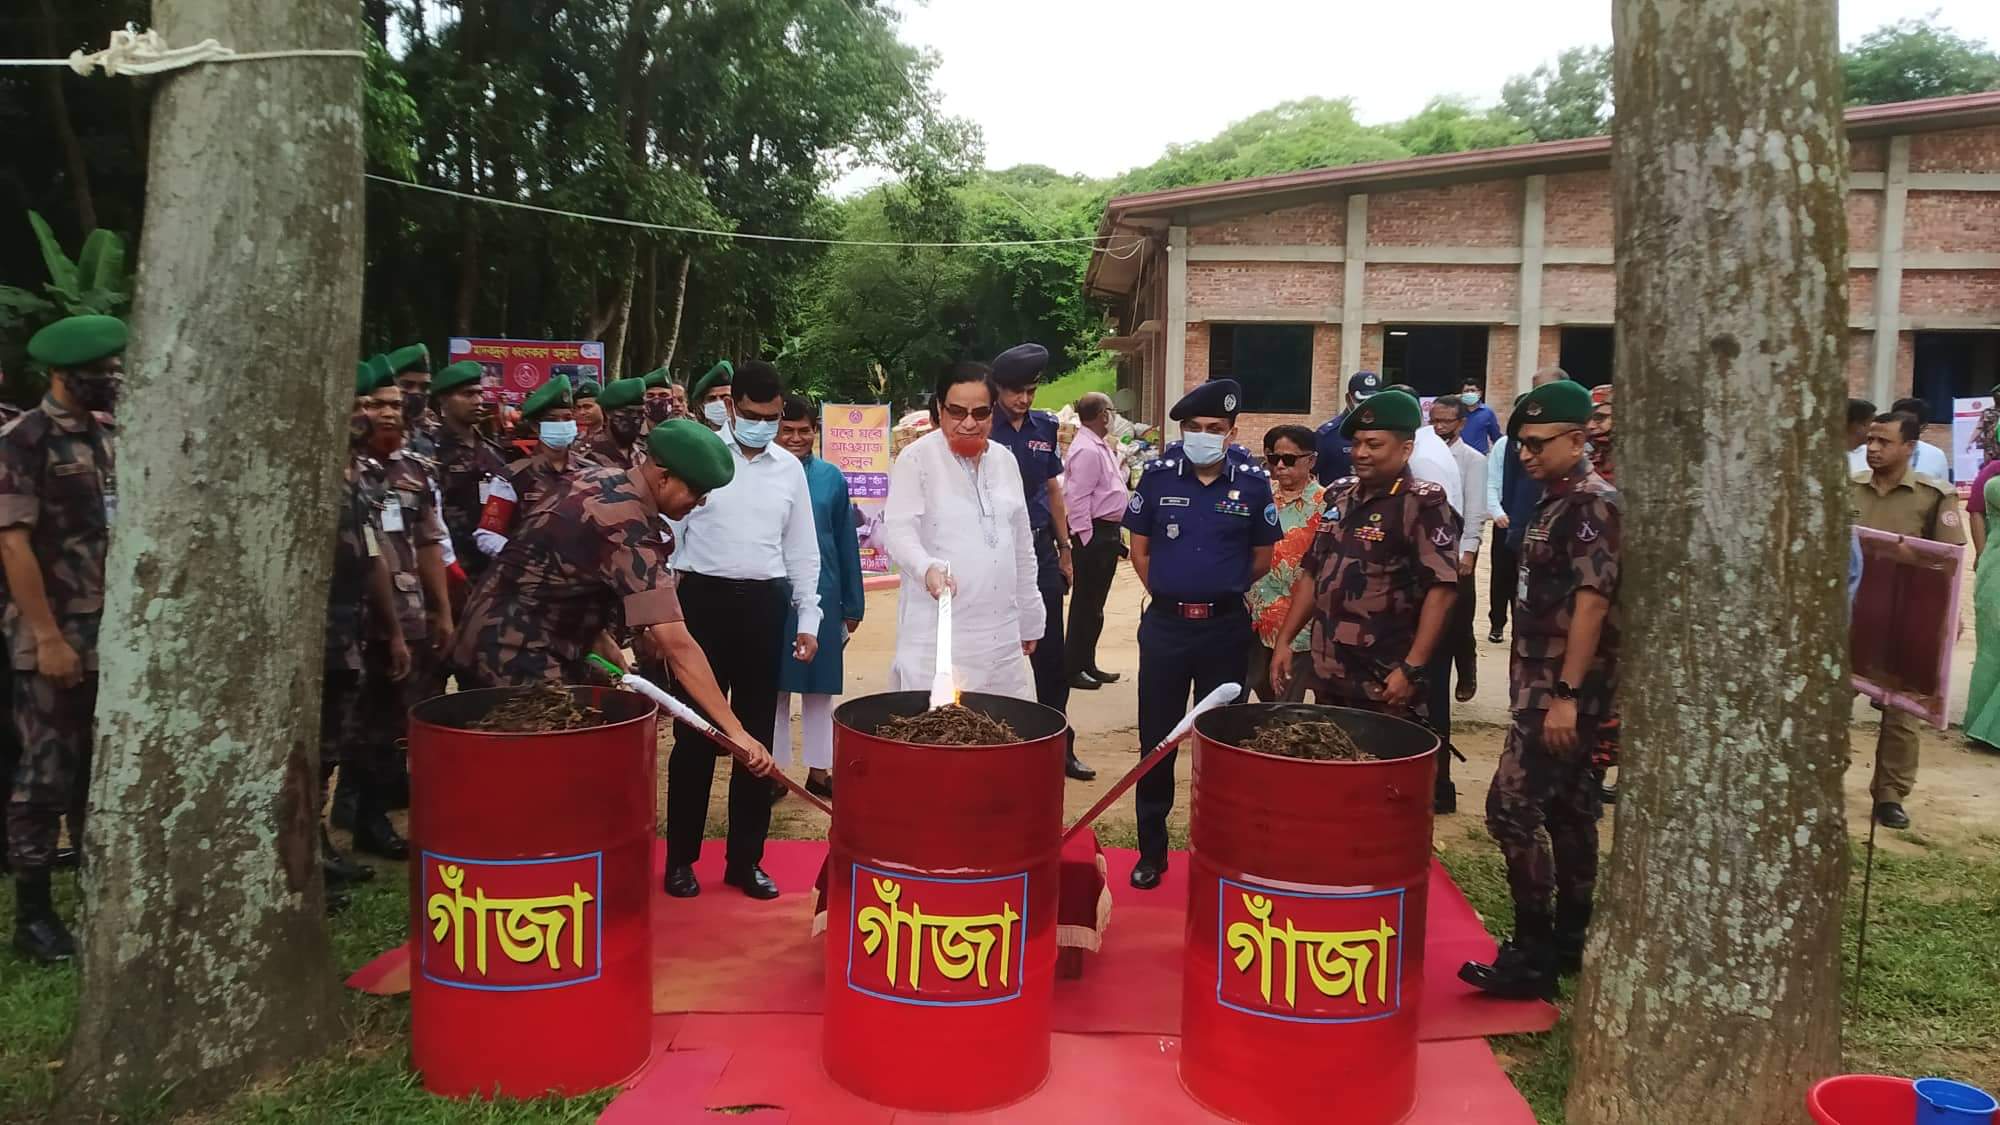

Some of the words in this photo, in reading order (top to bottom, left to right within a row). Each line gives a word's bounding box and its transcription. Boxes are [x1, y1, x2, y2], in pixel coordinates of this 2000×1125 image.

[831, 428, 853, 439] ঘরে
[859, 428, 882, 440] ঘরে
[831, 442, 882, 454] আওয়াজ
[840, 456, 873, 469] তুলুন
[427, 864, 594, 977] গাঁজা
[857, 877, 1021, 991] গাঁজা
[1227, 892, 1397, 1009] গাঁজা
